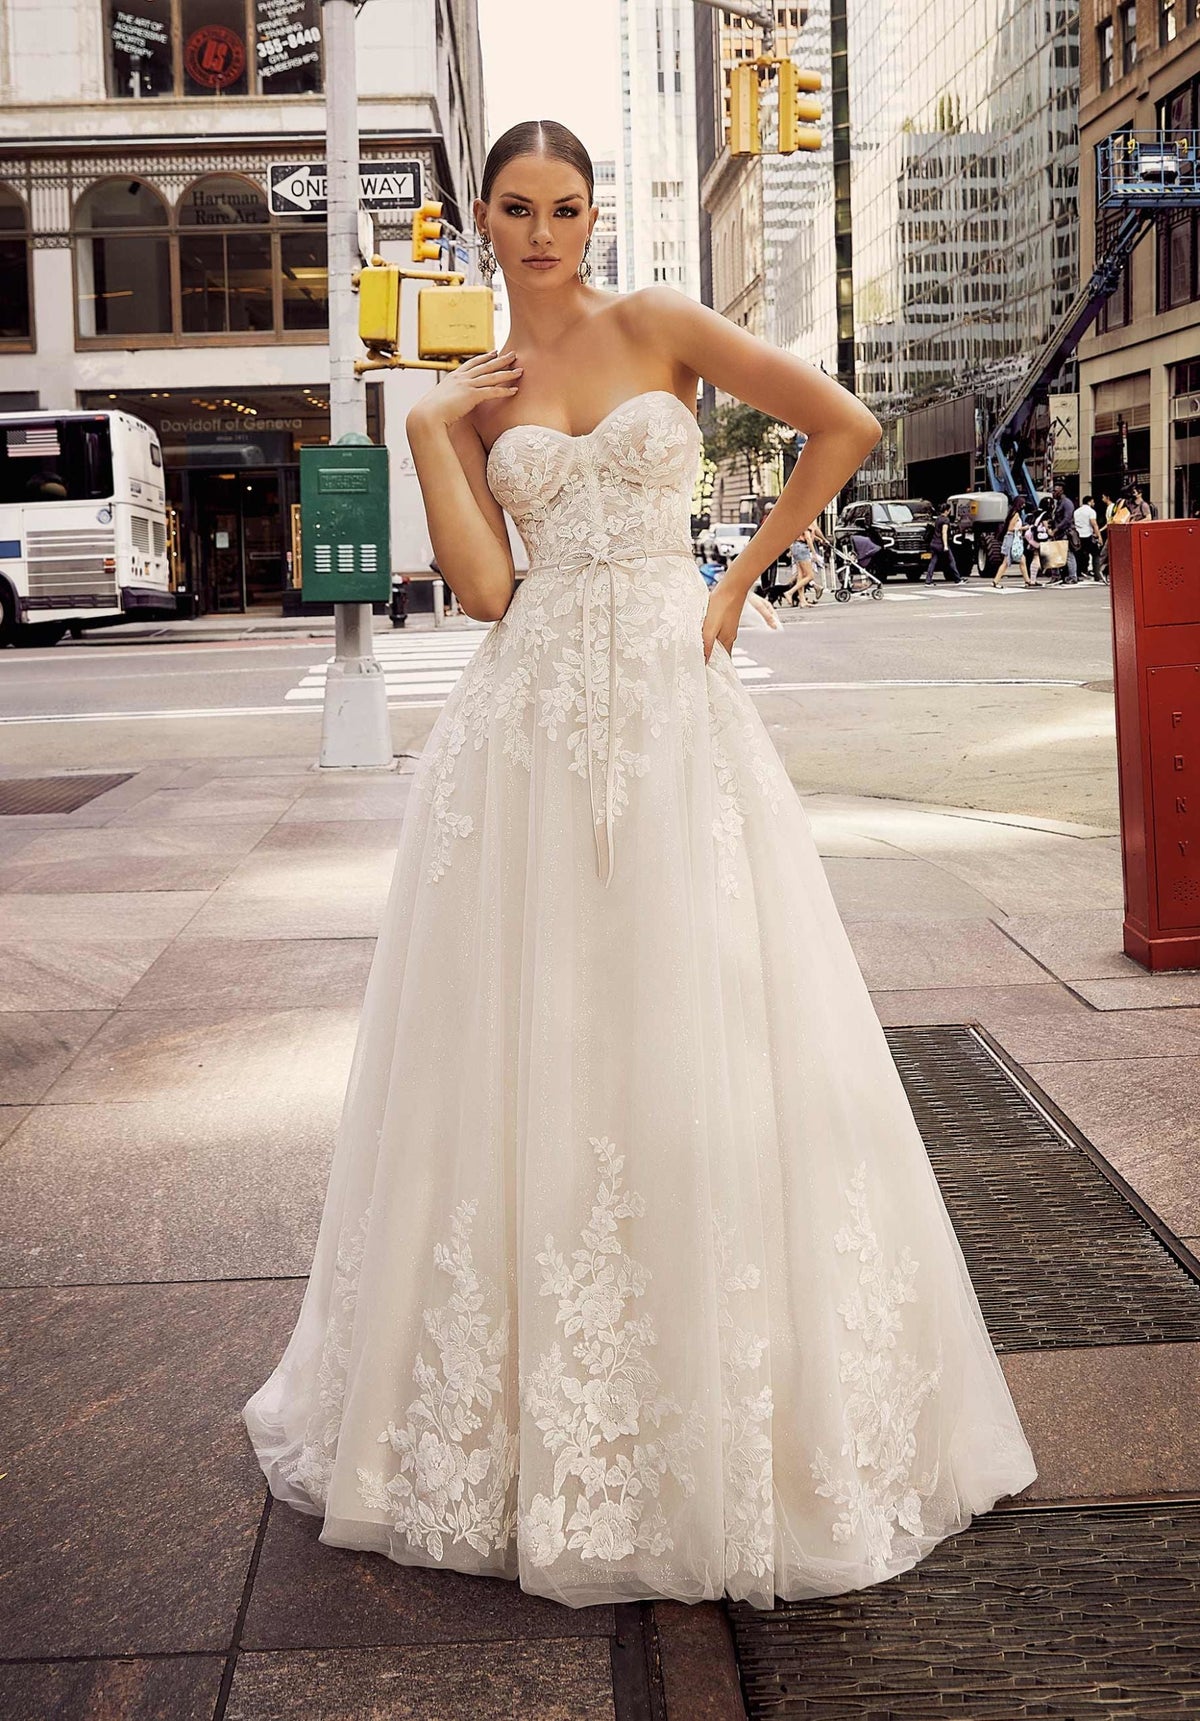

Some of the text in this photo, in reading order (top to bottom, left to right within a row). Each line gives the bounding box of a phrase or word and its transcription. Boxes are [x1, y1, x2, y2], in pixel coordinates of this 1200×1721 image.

[267, 1, 306, 19] THERAPY
[117, 11, 164, 31] THE ART OF
[256, 17, 289, 33] PRIVATE
[111, 30, 146, 48] SPORTS
[113, 22, 168, 44] AGGRESSIVE
[264, 22, 303, 39] TRAINING
[115, 40, 154, 59] THERAPY
[256, 26, 321, 58] 355-8440
[257, 51, 319, 77] MEMBERSHIPS
[268, 51, 289, 65] GYM
[361, 177, 407, 195] WAY
[192, 190, 259, 207] Hartman
[195, 208, 258, 225] Rare Art
[161, 417, 302, 432] Davidoff of Geneva
[1172, 711, 1188, 857] FDNY
